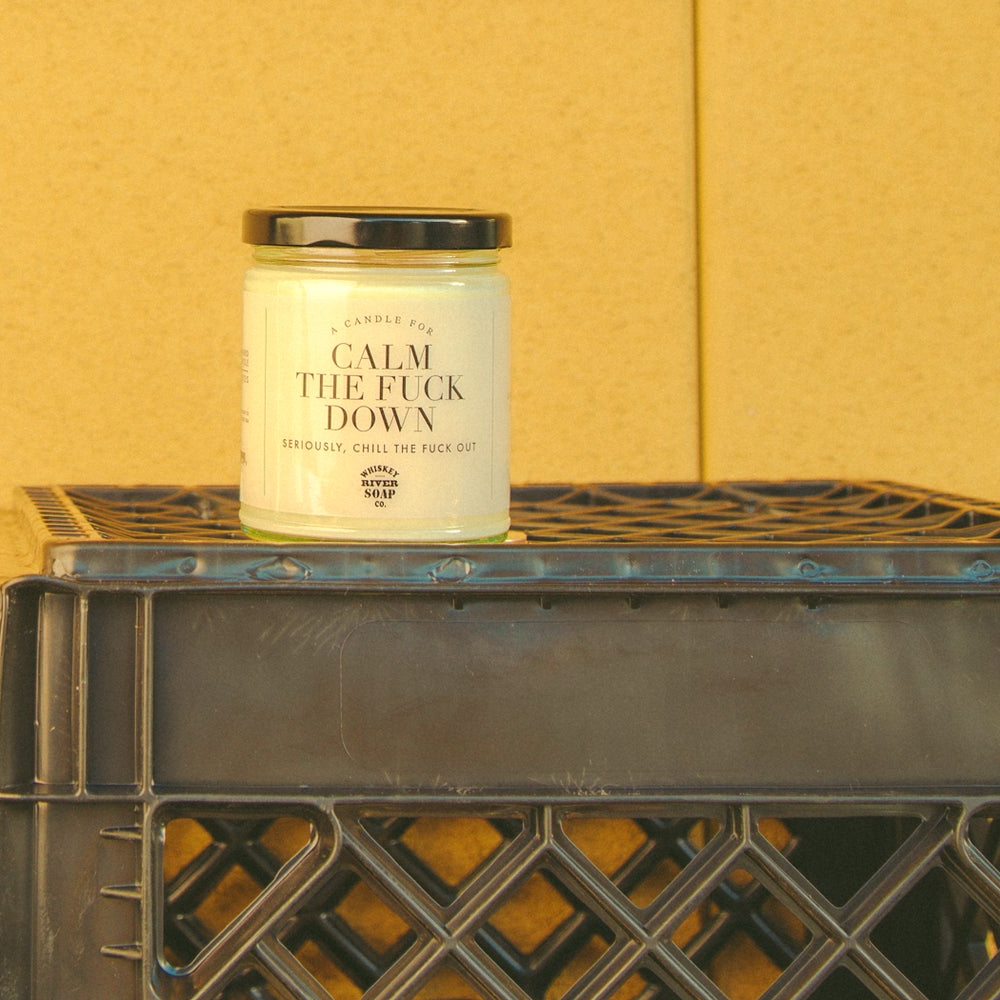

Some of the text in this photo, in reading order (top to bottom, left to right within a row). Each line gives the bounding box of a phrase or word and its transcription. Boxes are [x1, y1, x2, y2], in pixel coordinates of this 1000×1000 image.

[331, 315, 434, 336] A CANDLE FOR
[331, 342, 433, 370] CALM
[296, 372, 465, 401] THE FUCK
[324, 405, 436, 433] DOWN
[282, 438, 477, 454] SERIOUSLY, CHILL THE FUCK OUT
[360, 464, 400, 478] WHISKEY
[361, 479, 399, 488] RIVER
[364, 488, 396, 499] SOAP
